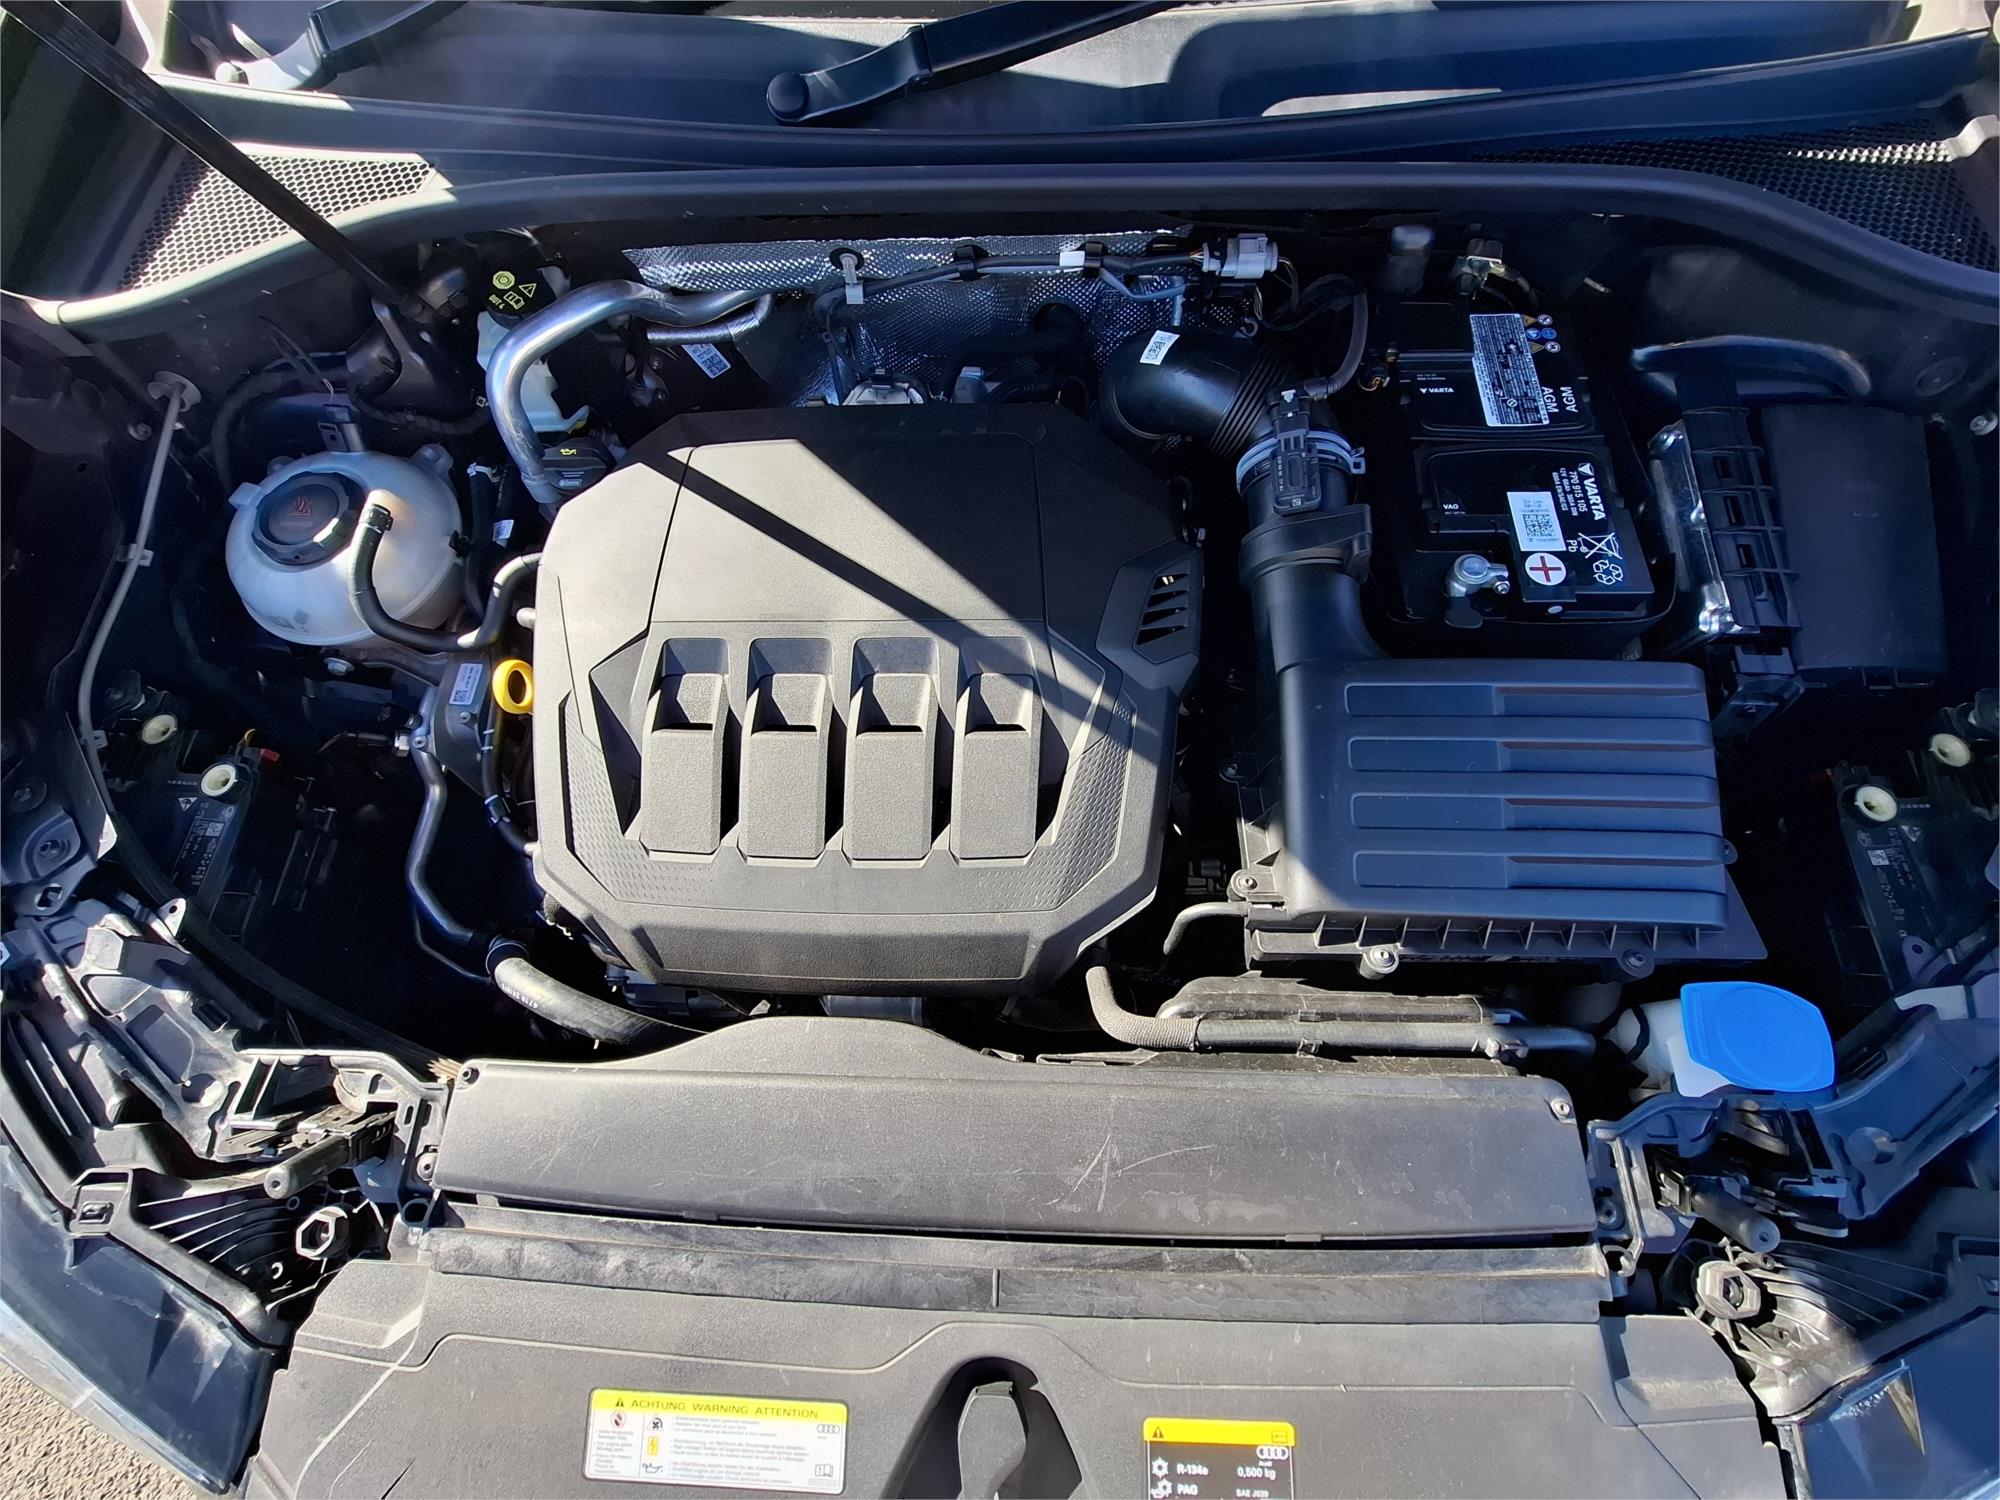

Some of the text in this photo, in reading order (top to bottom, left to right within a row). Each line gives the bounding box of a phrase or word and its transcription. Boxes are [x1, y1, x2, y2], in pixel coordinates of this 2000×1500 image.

[1541, 386, 1559, 413] AGM
[1560, 386, 1579, 413] AGM
[1572, 485, 1583, 498] 915
[1583, 477, 1606, 520] VARTA
[1577, 498, 1588, 512] 105
[1566, 539, 1579, 553] Pb
[630, 1399, 818, 1418] ACHTUNG WARNING ATTENTION
[1237, 1466, 1263, 1478] 0,500
[1264, 1467, 1276, 1480] kg
[1177, 1484, 1198, 1496] PAG
